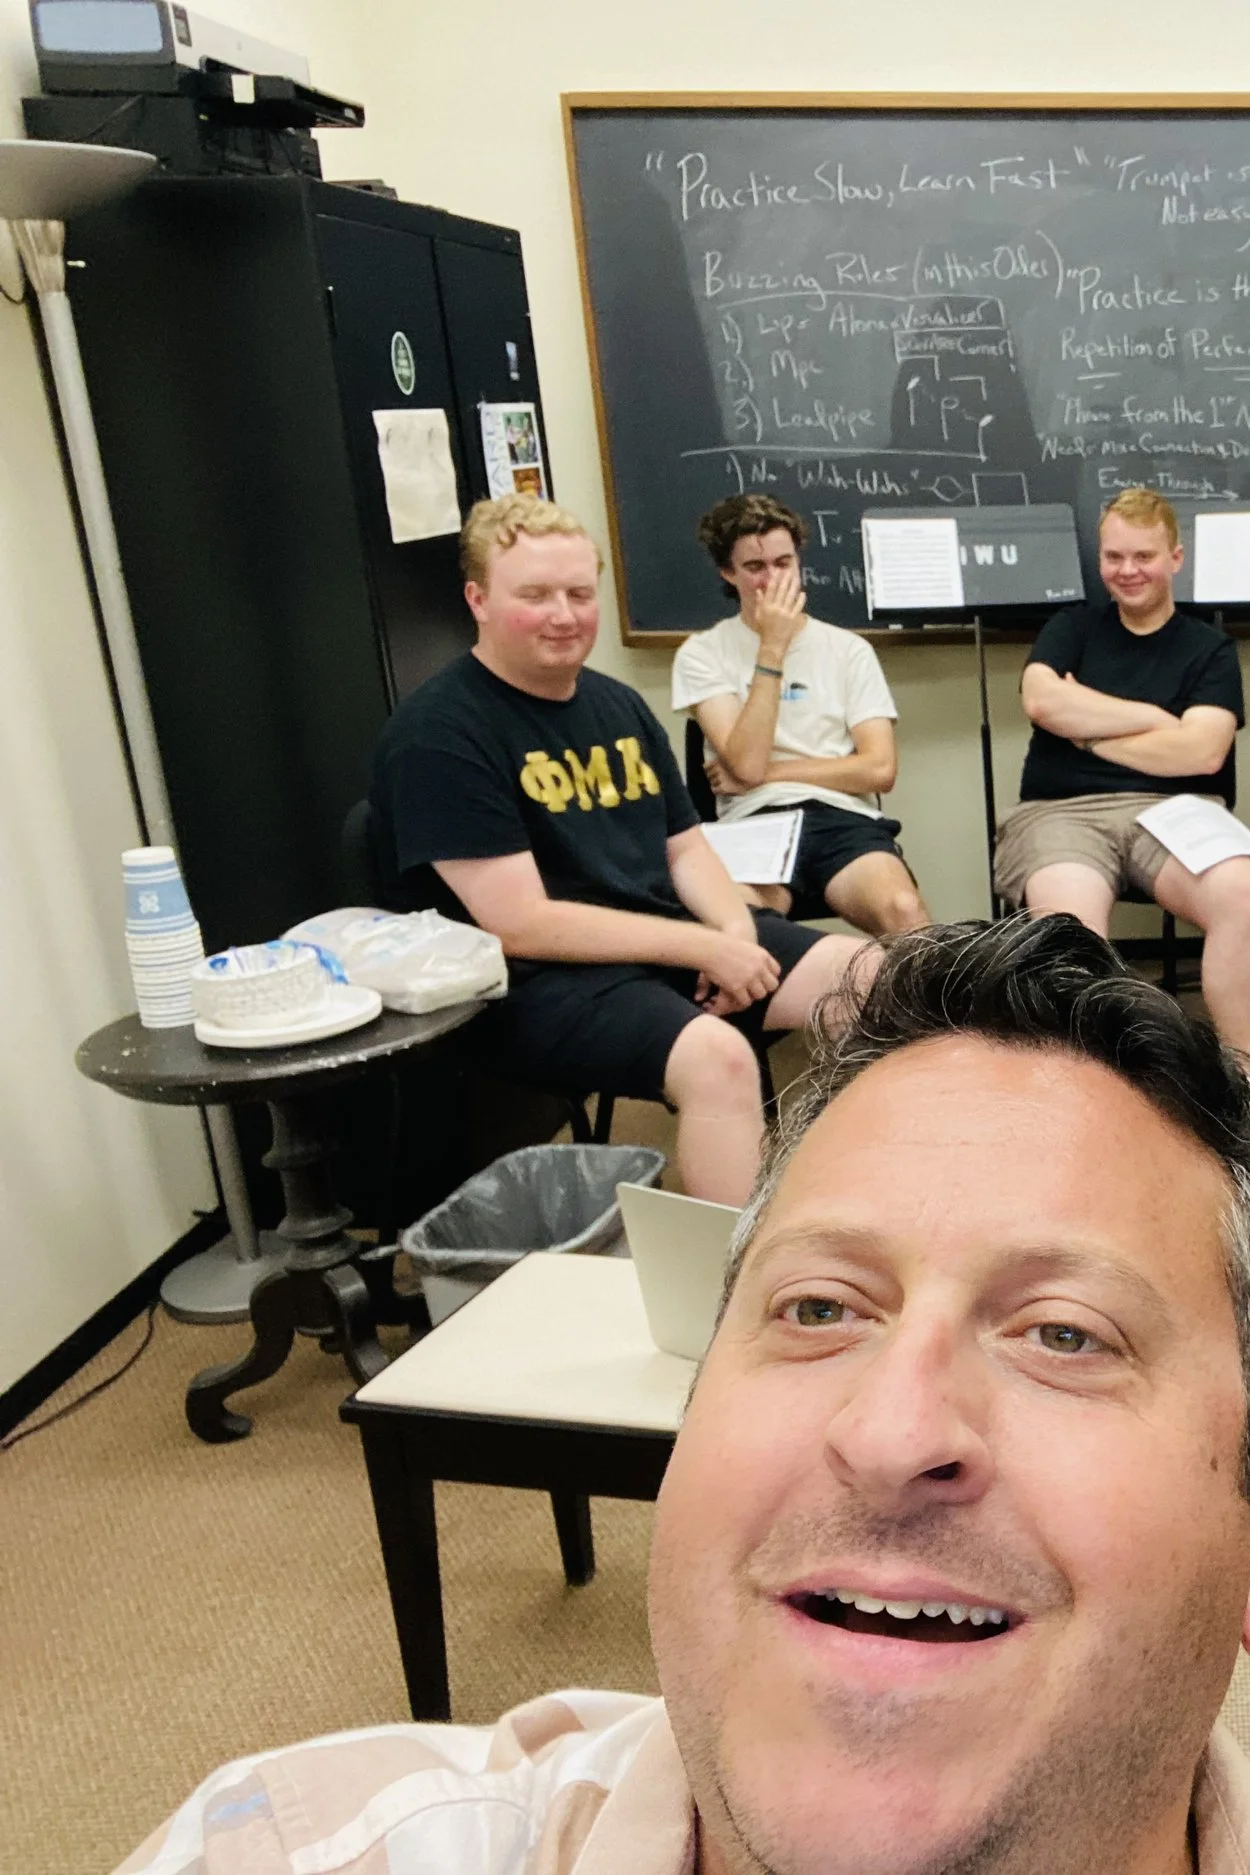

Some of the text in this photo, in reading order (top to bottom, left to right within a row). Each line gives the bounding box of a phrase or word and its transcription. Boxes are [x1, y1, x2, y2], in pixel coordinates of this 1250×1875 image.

[900, 164, 973, 194] Learn
[1162, 195, 1197, 225] Not
[703, 251, 827, 311] Buzzing
[1197, 279, 1220, 301] is
[1060, 327, 1152, 369] Repetition
[1156, 327, 1177, 359] of
[1120, 395, 1169, 424] from
[1173, 394, 1204, 425] the
